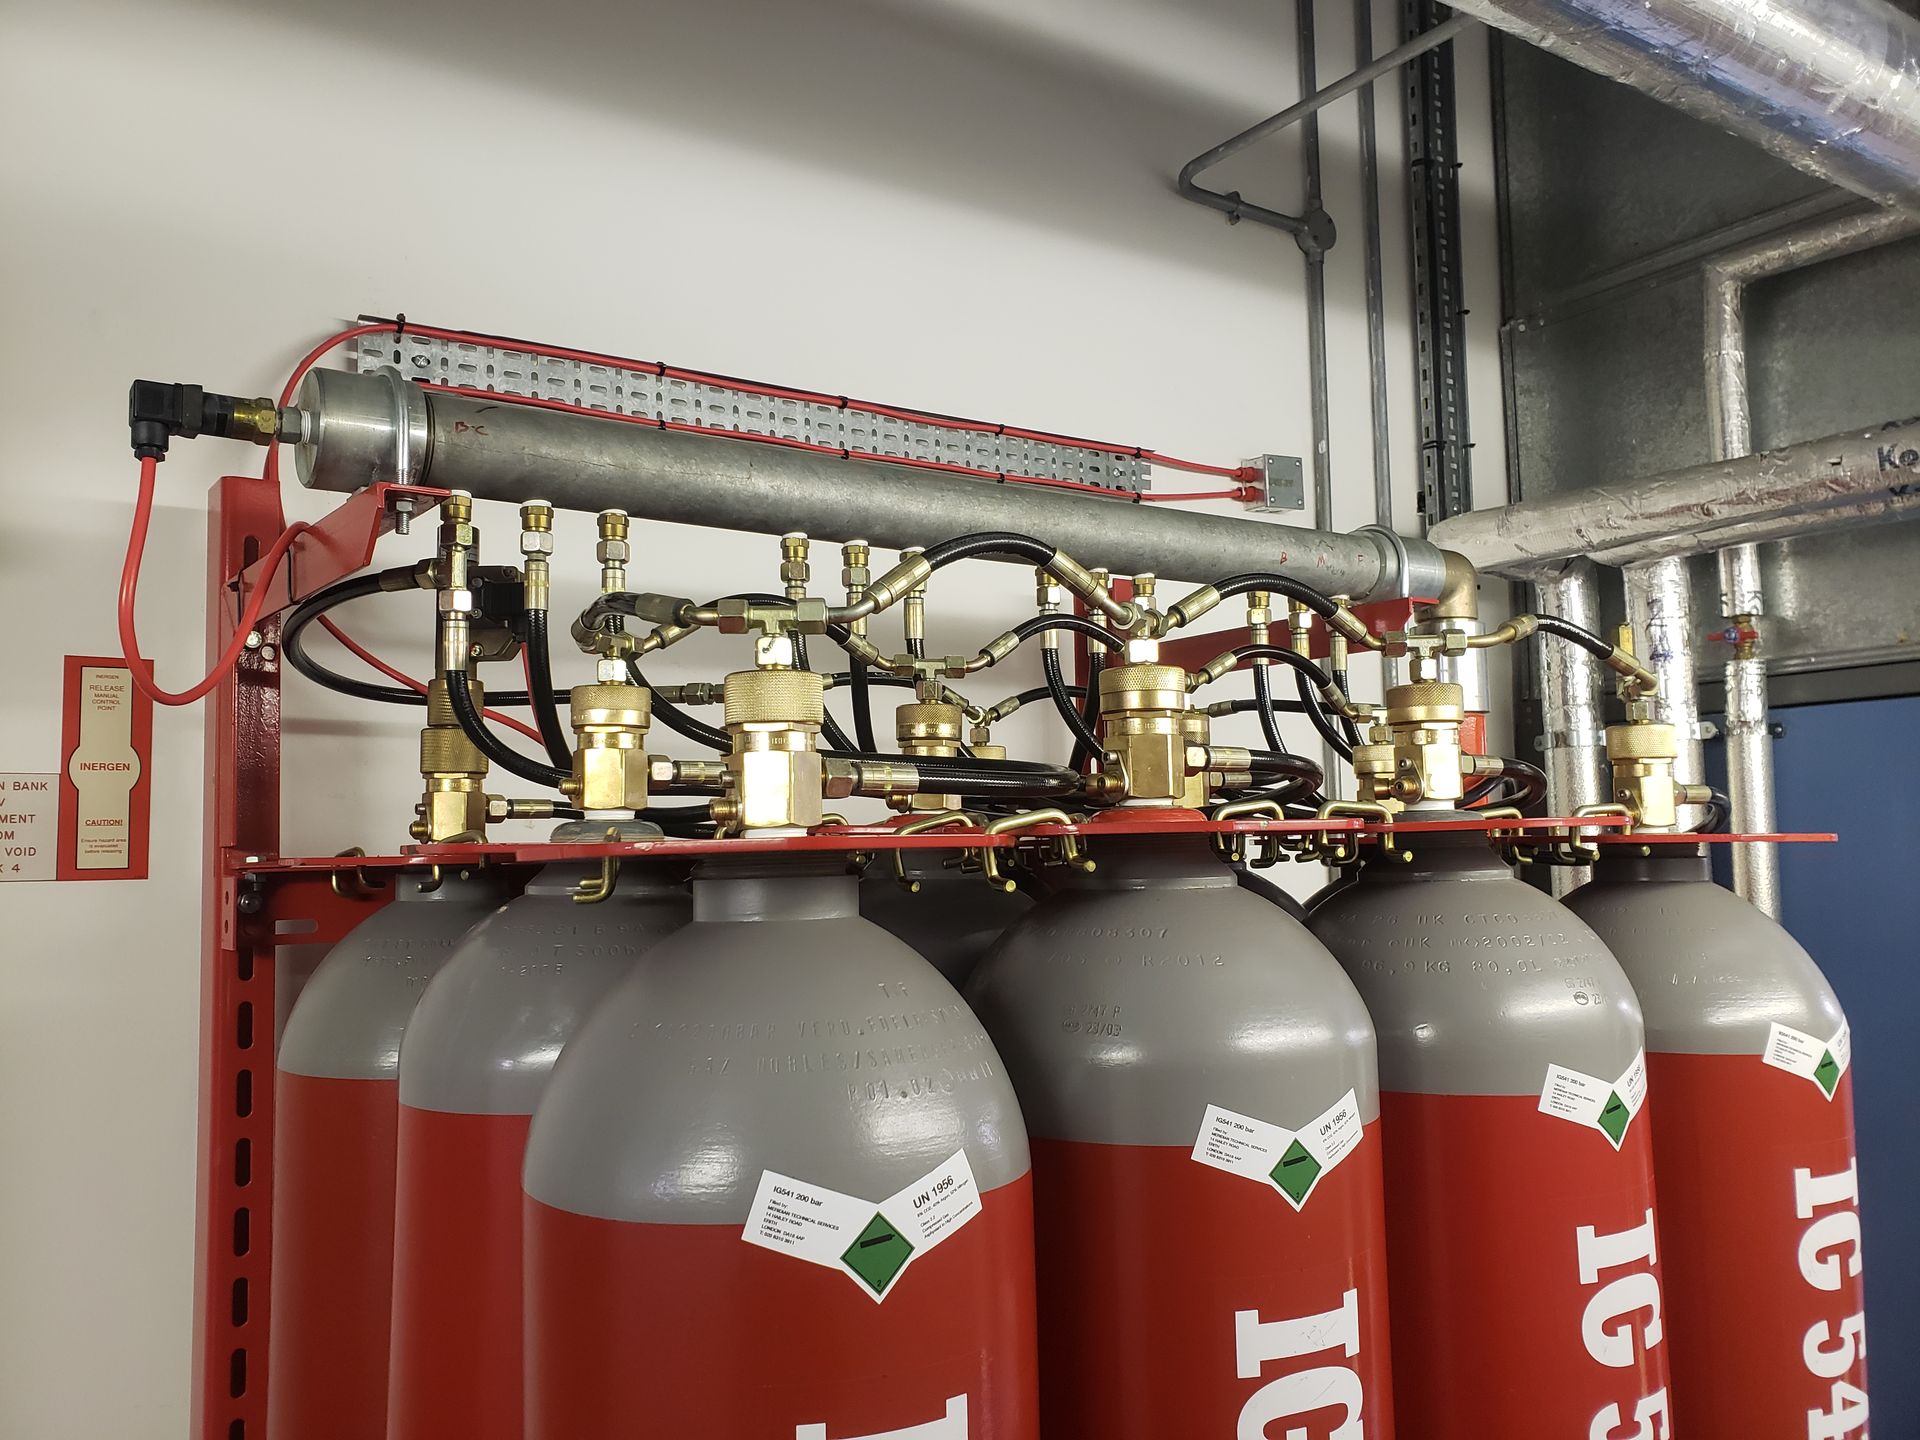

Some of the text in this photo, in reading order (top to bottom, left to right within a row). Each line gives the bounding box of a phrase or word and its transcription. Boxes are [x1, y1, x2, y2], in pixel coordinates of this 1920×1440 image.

[89, 684, 125, 692] RELEASE
[80, 762, 130, 771] INERGEN
[13, 781, 48, 791] BANK
[0, 814, 36, 824] MENT
[4, 847, 37, 857] VOID
[12, 864, 20, 873] 4
[1216, 1116, 1255, 1133] IG541 200 bar
[1320, 1109, 1347, 1136] UN 1956
[1230, 1138, 1250, 1148] TECHNICAL
[1206, 1147, 1223, 1155] LONDON
[773, 1185, 823, 1207] IG541 200 bar
[913, 1175, 954, 1209] UN 1956
[763, 1218, 778, 1226] ERITH
[767, 1205, 840, 1231] MERIDIAN TECHNICAL SERVICES
[789, 1219, 803, 1227] ROAD
[1794, 1156, 1862, 1291] IG
[761, 1224, 782, 1234] LONDON
[877, 1279, 882, 1287] 2
[1576, 1207, 1670, 1440] IG 5
[1234, 1287, 1364, 1440] IG
